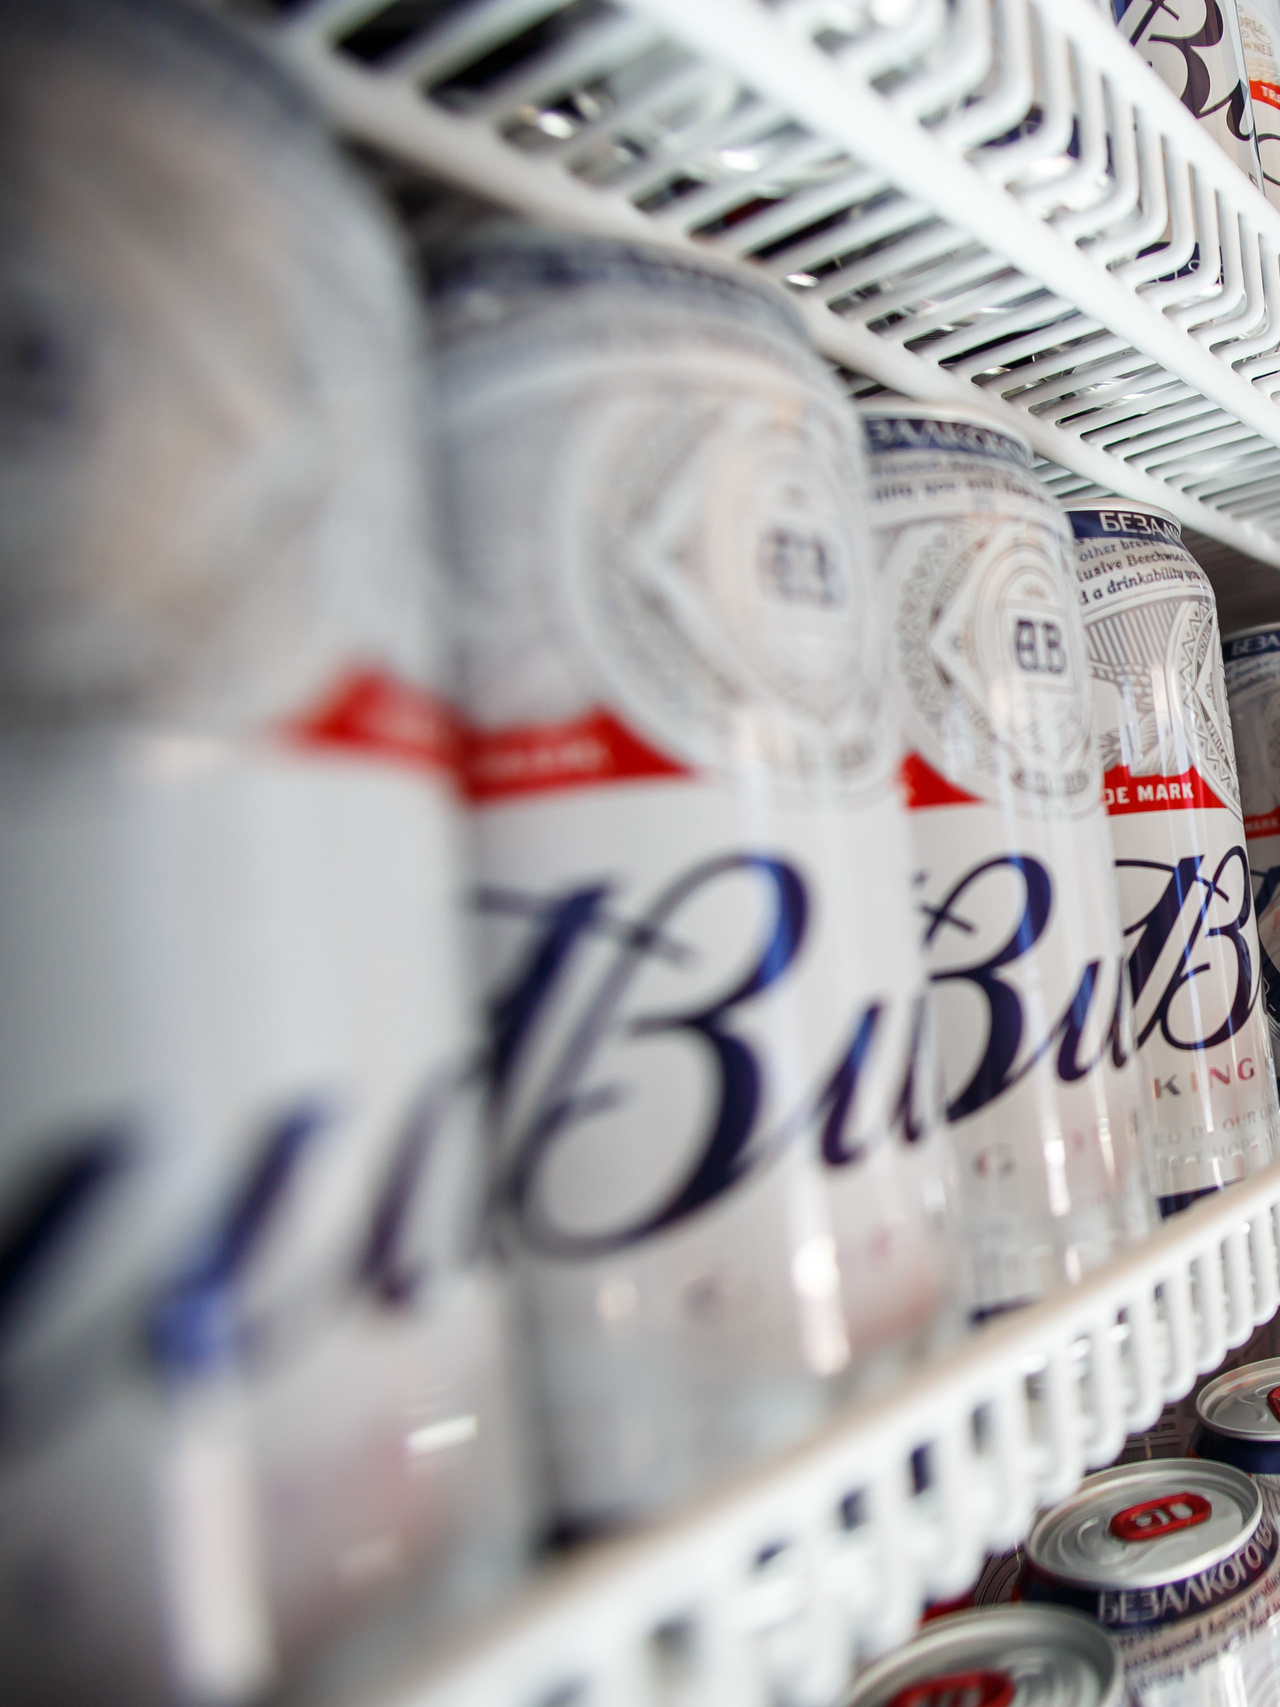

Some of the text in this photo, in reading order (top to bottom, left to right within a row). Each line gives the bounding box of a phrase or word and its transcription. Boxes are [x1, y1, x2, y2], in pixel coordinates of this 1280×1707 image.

[1099, 511, 1181, 540] БЕЗАЛ
[1076, 561, 1122, 582] lusive
[1093, 589, 1103, 600] a
[1104, 780, 1195, 806] DE MARK
[1153, 1056, 1256, 1100] KING
